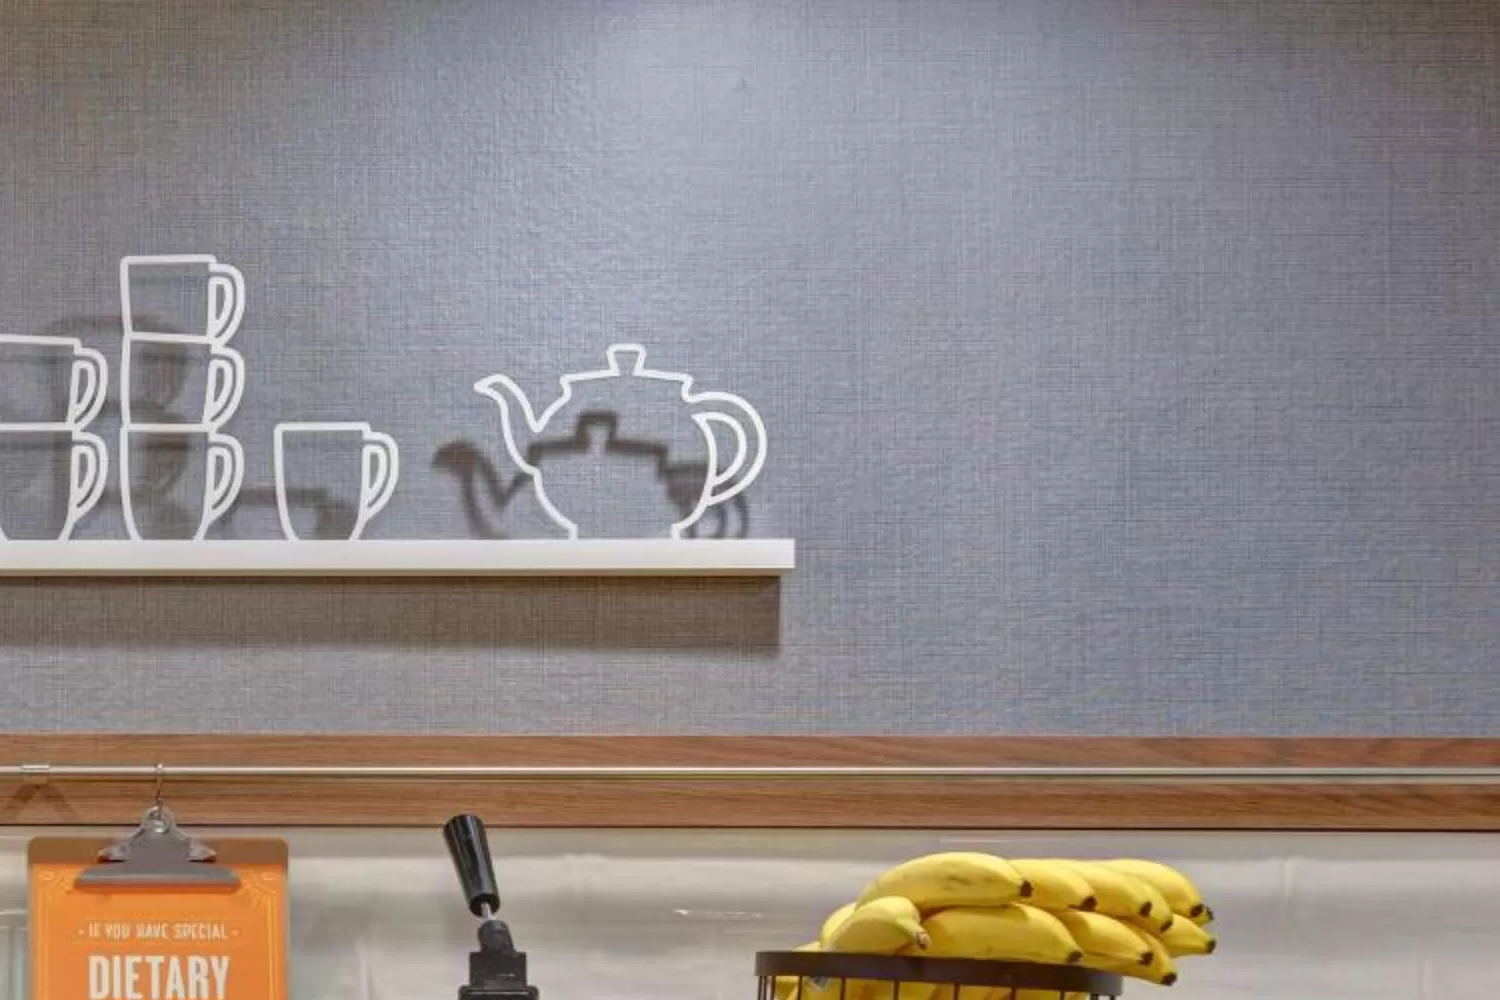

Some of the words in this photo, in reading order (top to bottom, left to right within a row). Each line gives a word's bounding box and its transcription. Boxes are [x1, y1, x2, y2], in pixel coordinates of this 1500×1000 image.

[88, 921, 100, 939] IF
[105, 922, 130, 940] YOU
[136, 922, 169, 940] HAVE
[172, 922, 229, 940] SPECIAL
[88, 955, 230, 1000] DIETARY
